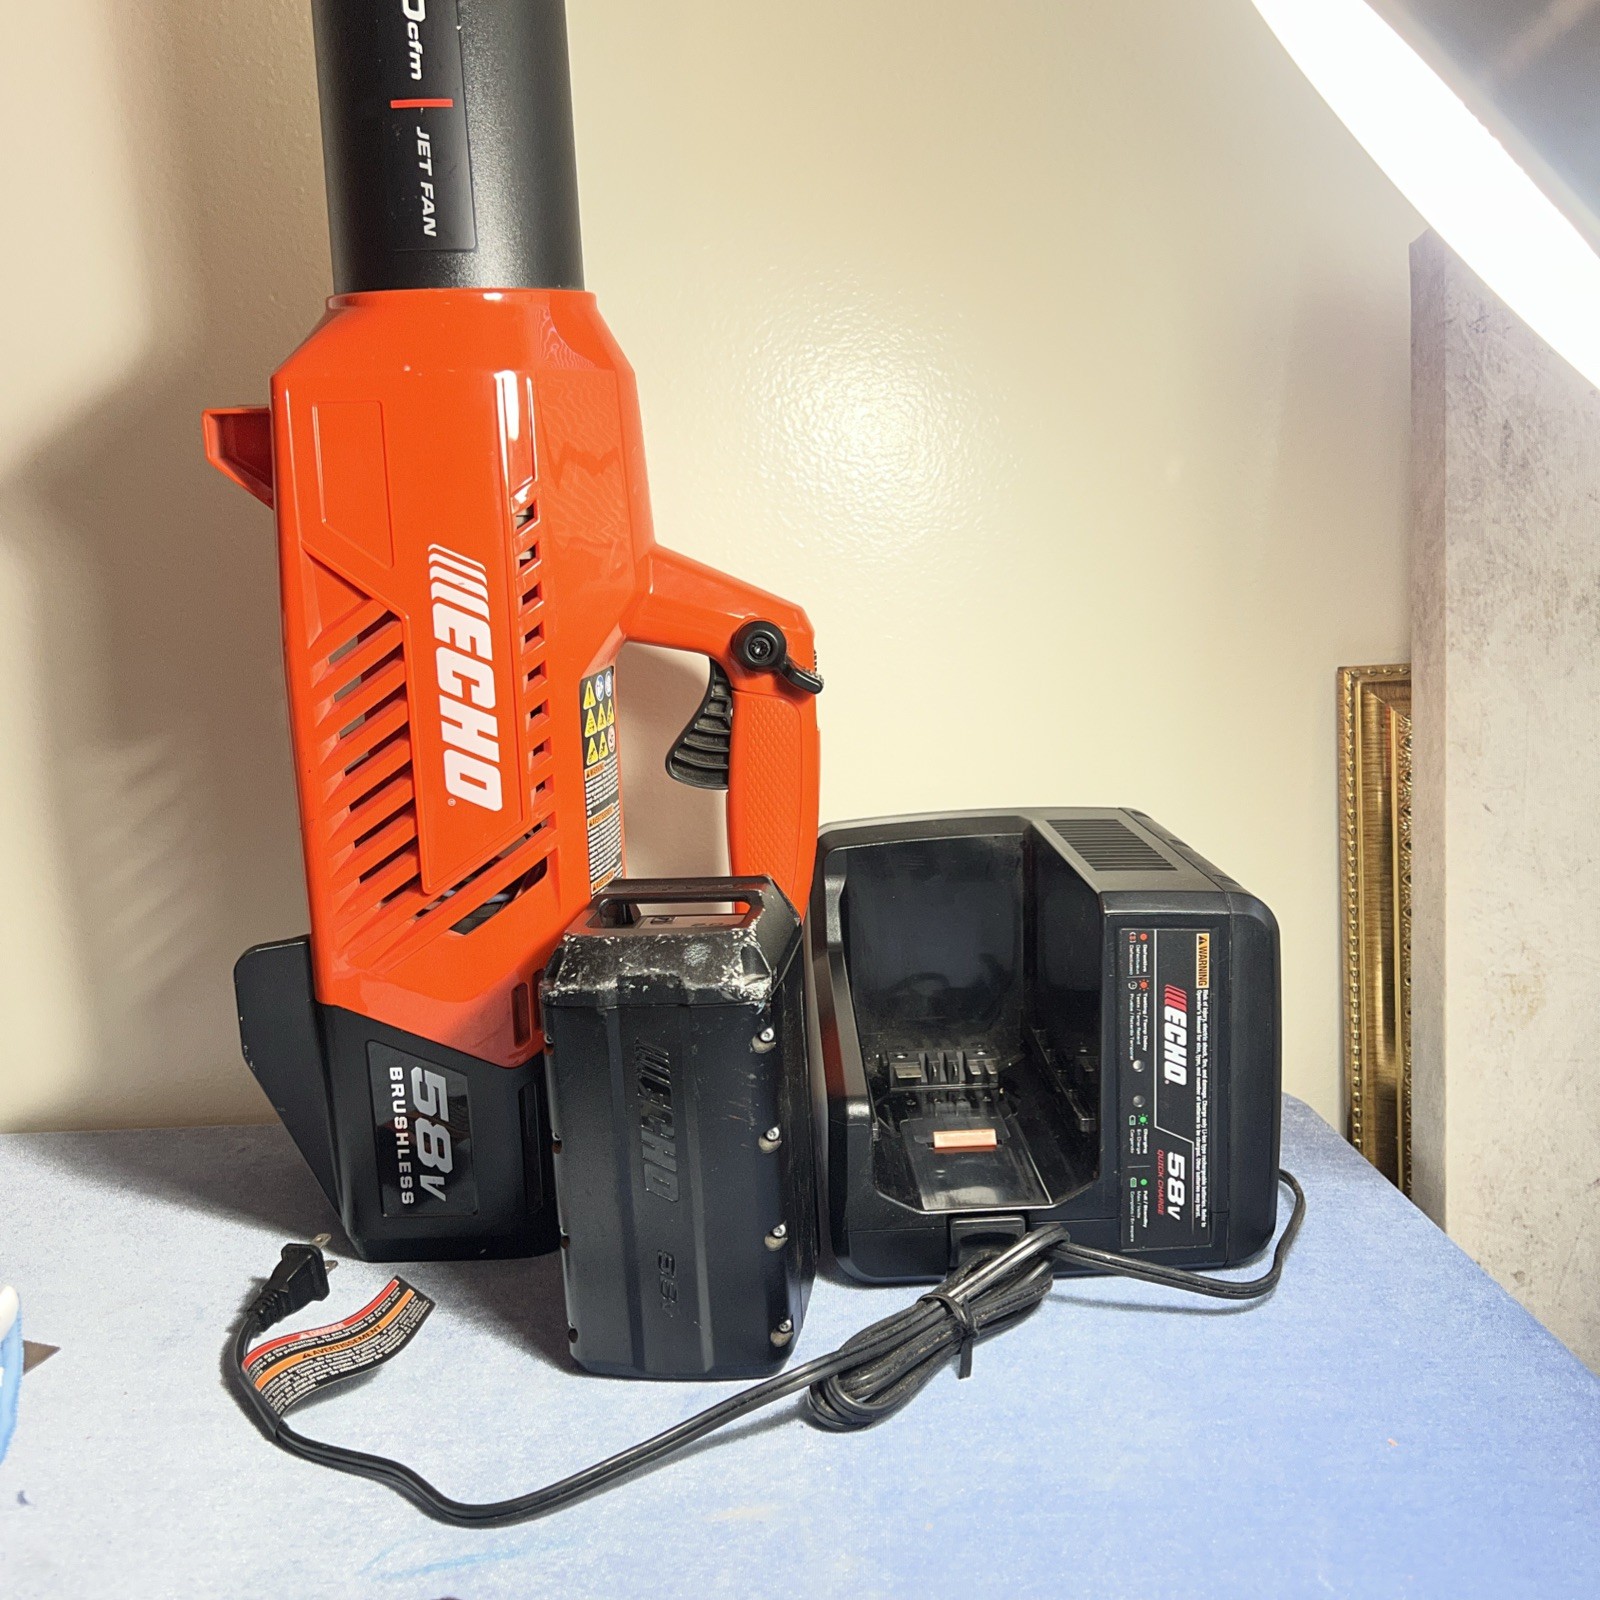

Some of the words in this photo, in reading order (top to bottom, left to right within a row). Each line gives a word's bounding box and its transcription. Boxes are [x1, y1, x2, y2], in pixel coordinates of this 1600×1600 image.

[416, 126, 432, 176] JET
[420, 182, 437, 237] FAN
[432, 602, 503, 811] ECHO
[1198, 946, 1207, 986] WARNING
[1164, 1007, 1187, 1084] ECHO
[389, 1067, 414, 1204] BRUSHLESS
[638, 1077, 679, 1202] ECHO
[1157, 1150, 1165, 1177] QUICK
[1157, 1179, 1165, 1215] CHARGE
[312, 1323, 381, 1356] AVERTISSEMENT
